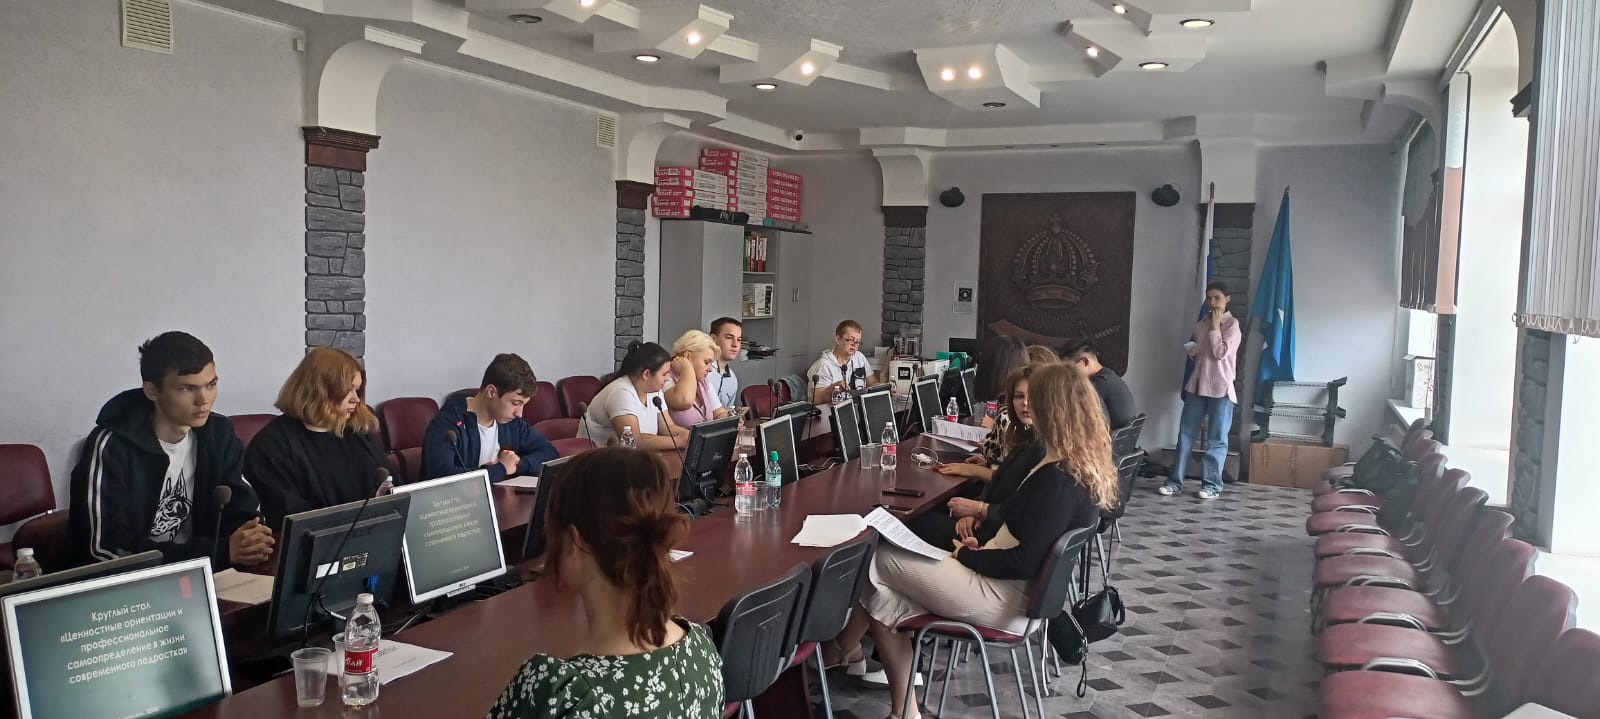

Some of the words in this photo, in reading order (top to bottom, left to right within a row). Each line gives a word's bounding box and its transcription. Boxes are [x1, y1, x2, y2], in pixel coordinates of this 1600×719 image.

[60, 622, 122, 643] «Ценностные
[124, 610, 176, 629] ориентации
[177, 608, 183, 616] и
[92, 604, 129, 622] Круглый
[130, 602, 151, 613] стол
[67, 643, 152, 670] самоопределение
[160, 634, 185, 647] жизни
[80, 624, 169, 654] профессиональное
[69, 661, 136, 684] современного
[137, 647, 188, 666] подростка»
